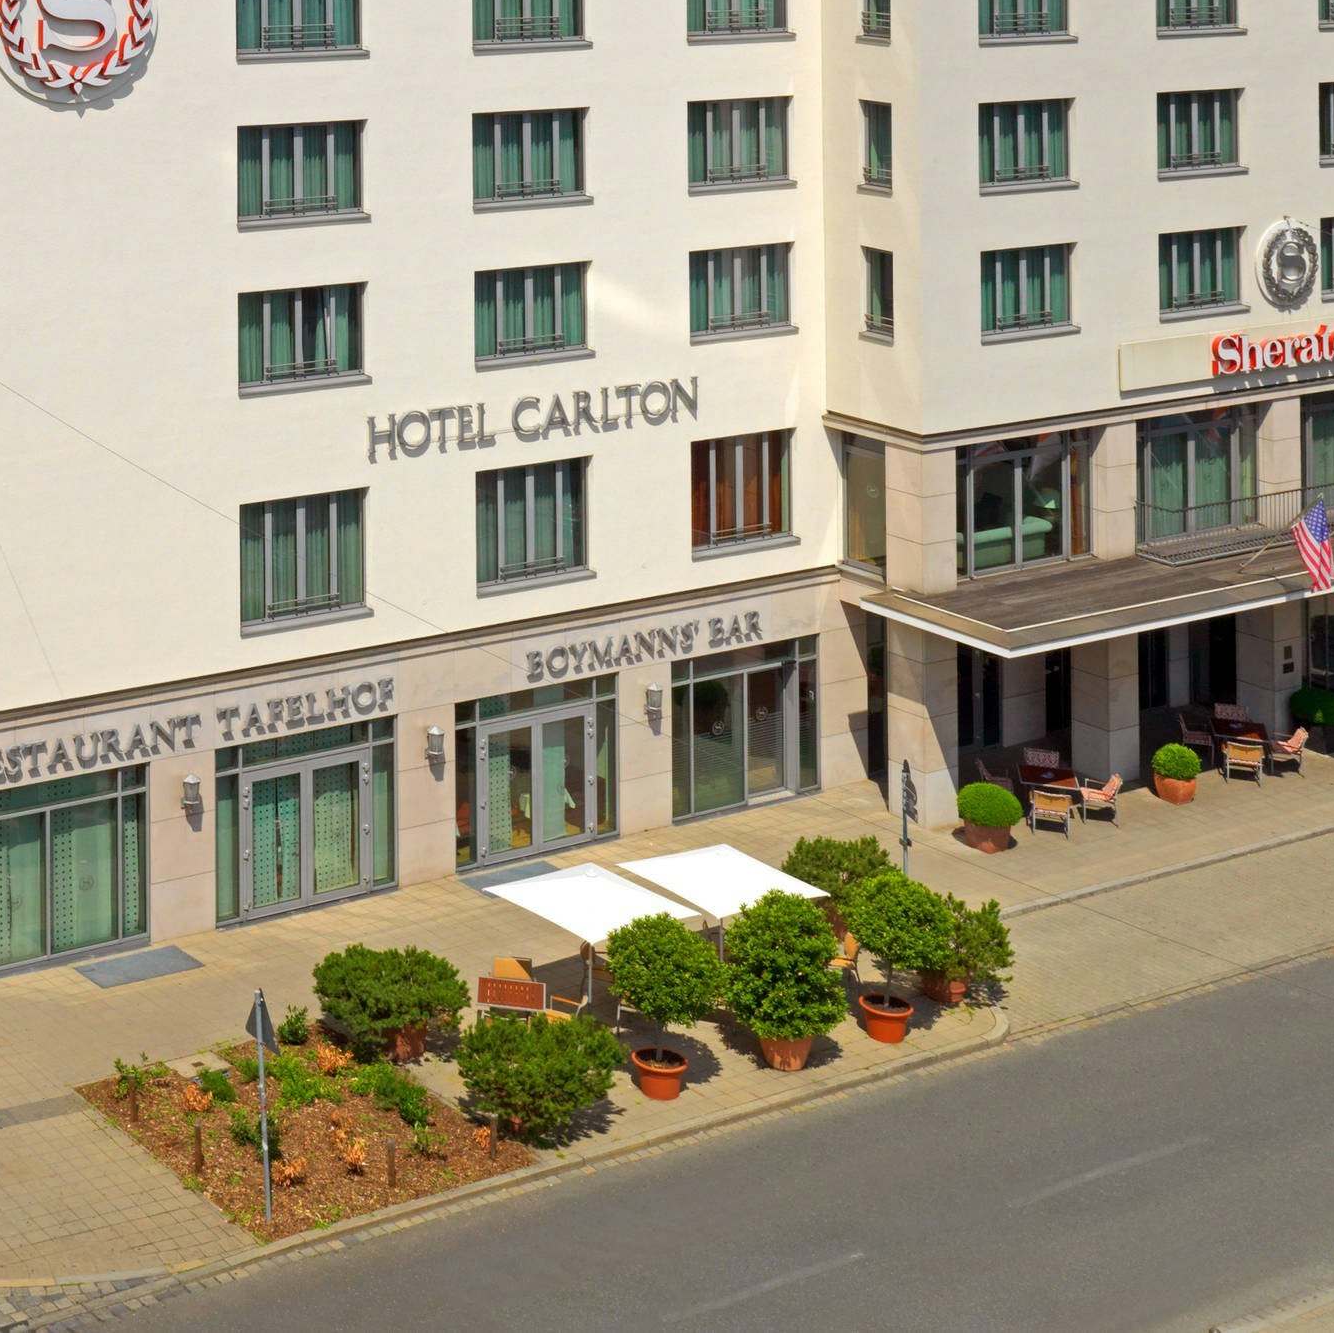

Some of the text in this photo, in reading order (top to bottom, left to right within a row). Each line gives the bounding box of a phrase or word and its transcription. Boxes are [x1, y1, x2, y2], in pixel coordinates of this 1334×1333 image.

[367, 376, 699, 458] HOTEL CARLTON
[525, 610, 764, 679] BOYMANNS' BAR
[217, 678, 395, 737] TAFELHOF
